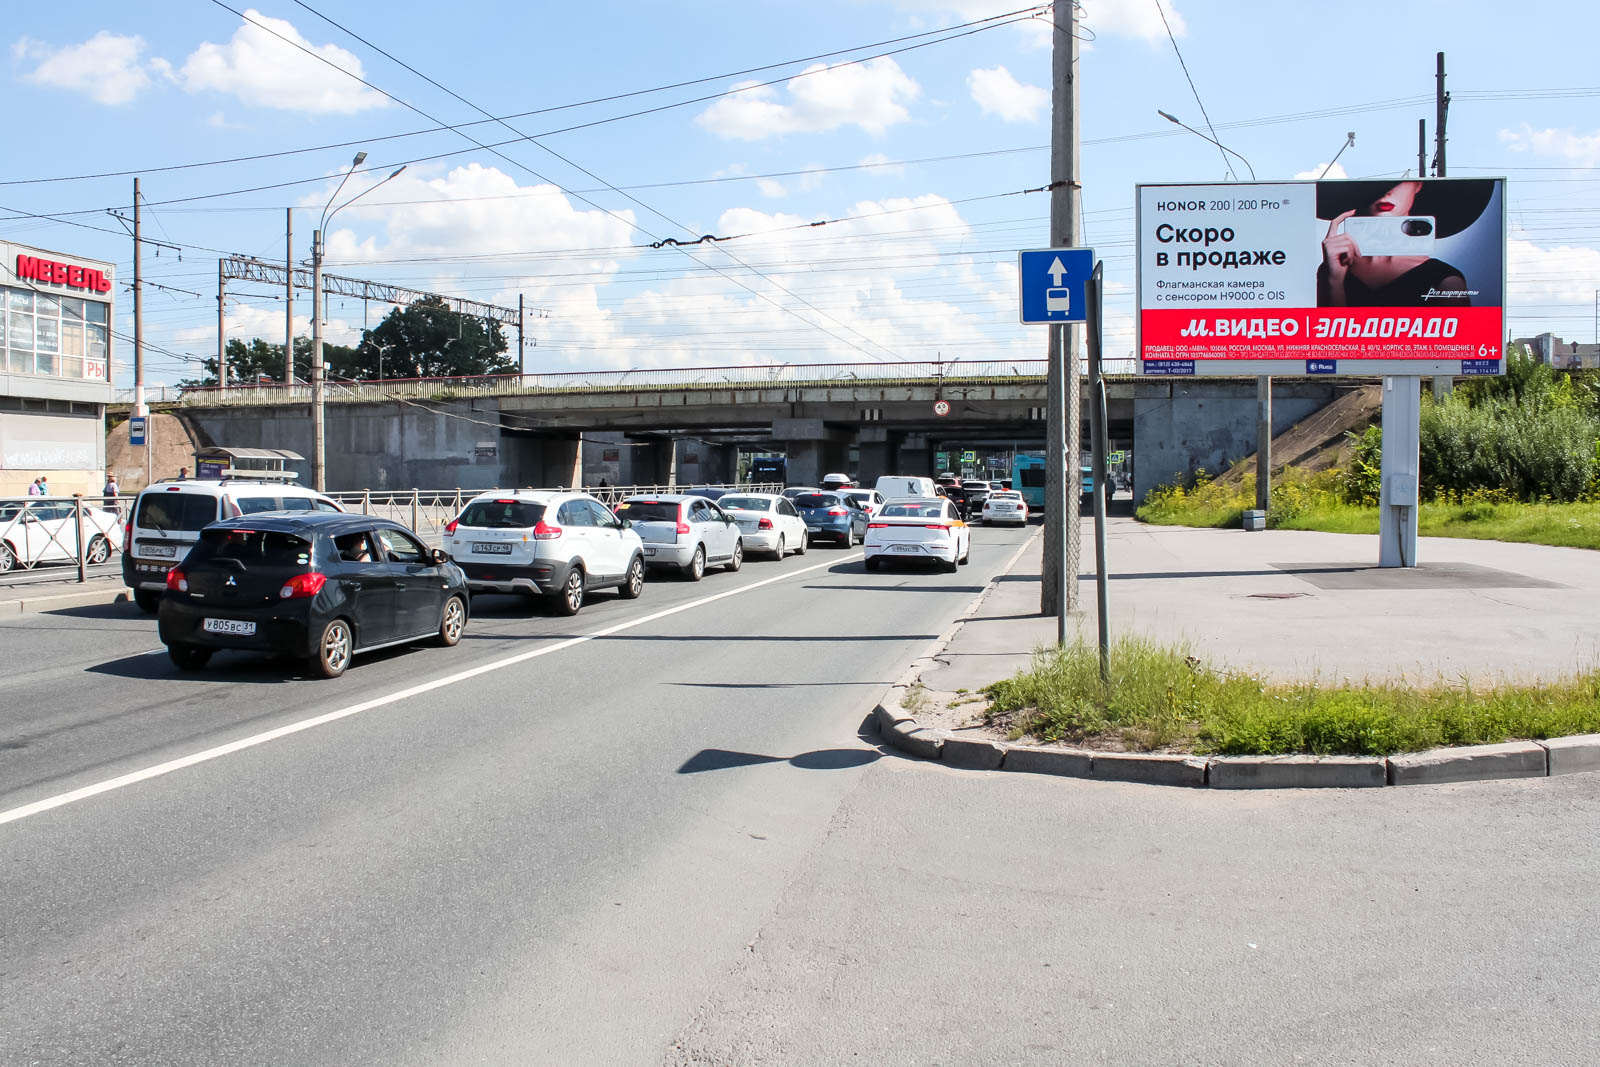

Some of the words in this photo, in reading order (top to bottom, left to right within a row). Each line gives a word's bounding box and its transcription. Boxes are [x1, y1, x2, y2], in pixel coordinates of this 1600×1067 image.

[1157, 201, 1206, 211] HONOR
[1210, 200, 1230, 211] 200
[1238, 199, 1257, 210] 200
[1261, 199, 1280, 210] Pro
[1156, 223, 1235, 247] Скоро
[1156, 252, 1169, 266] в
[1177, 250, 1286, 270] продаже
[17, 254, 112, 293] МЕБЕЛЬ
[1156, 279, 1225, 289] Флагманская
[1227, 280, 1265, 290] камера
[1165, 293, 1217, 302] сенсором
[1220, 291, 1256, 301] H9000
[1267, 290, 1285, 300] OIS
[1312, 317, 1458, 338] ЭЛЬДОРАДО
[1434, 344, 1468, 352] ПОМЕЩЕНИЕ
[1478, 344, 1498, 357] 6+
